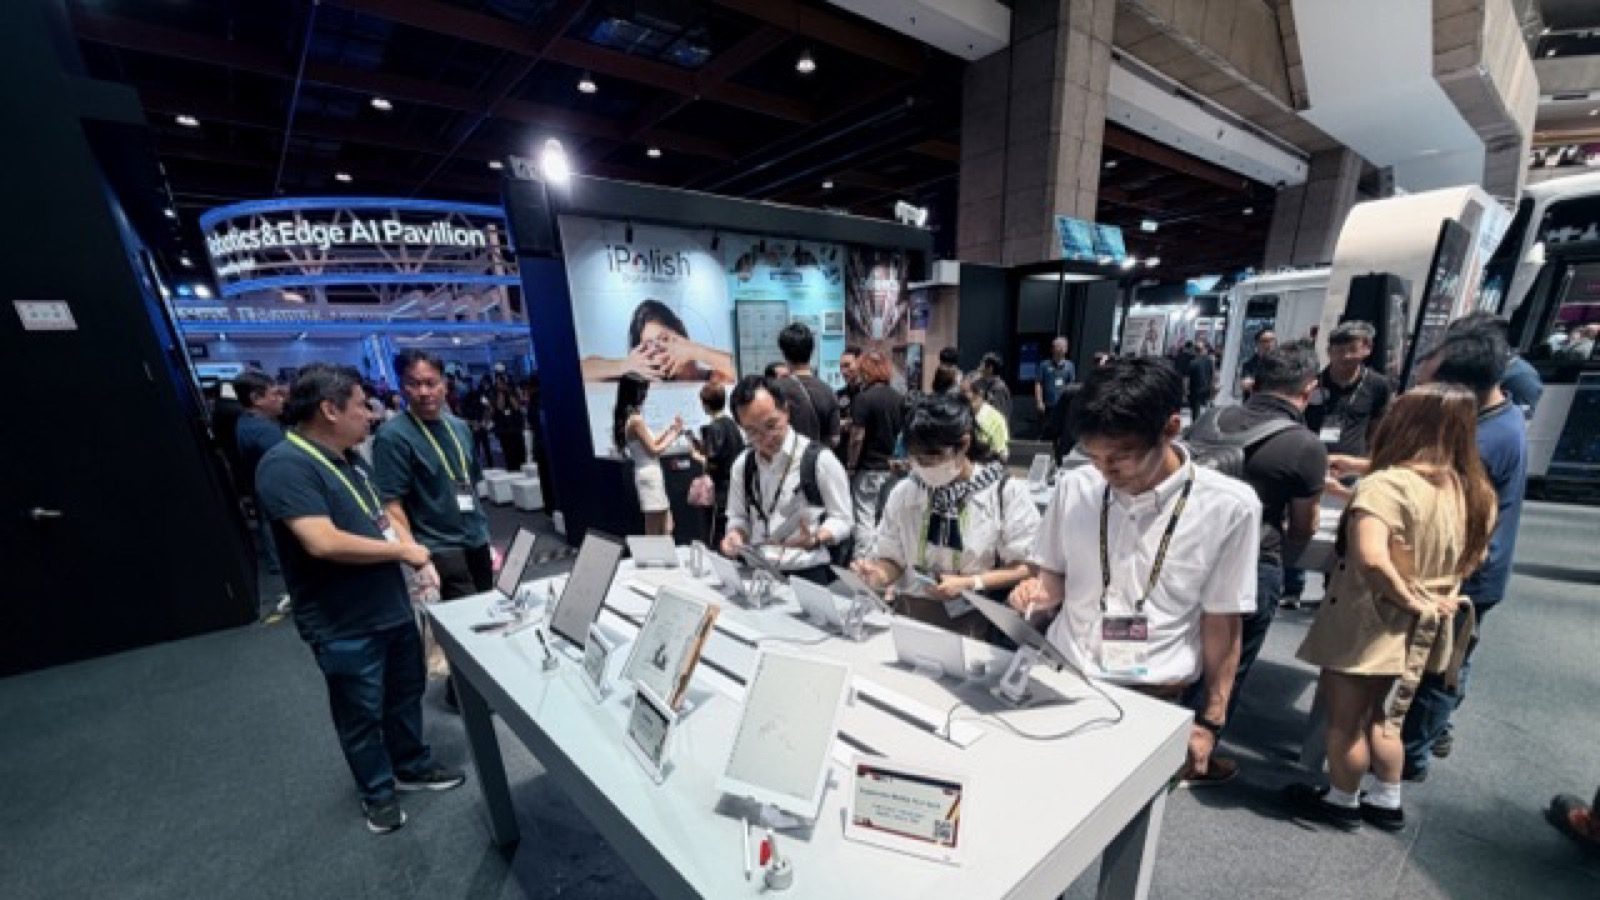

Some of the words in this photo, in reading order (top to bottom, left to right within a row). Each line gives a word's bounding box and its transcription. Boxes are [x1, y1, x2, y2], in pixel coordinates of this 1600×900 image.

[278, 219, 345, 250] Edge
[350, 219, 380, 243] AI
[381, 219, 486, 246] Pavilion
[606, 244, 691, 275] iPolish
